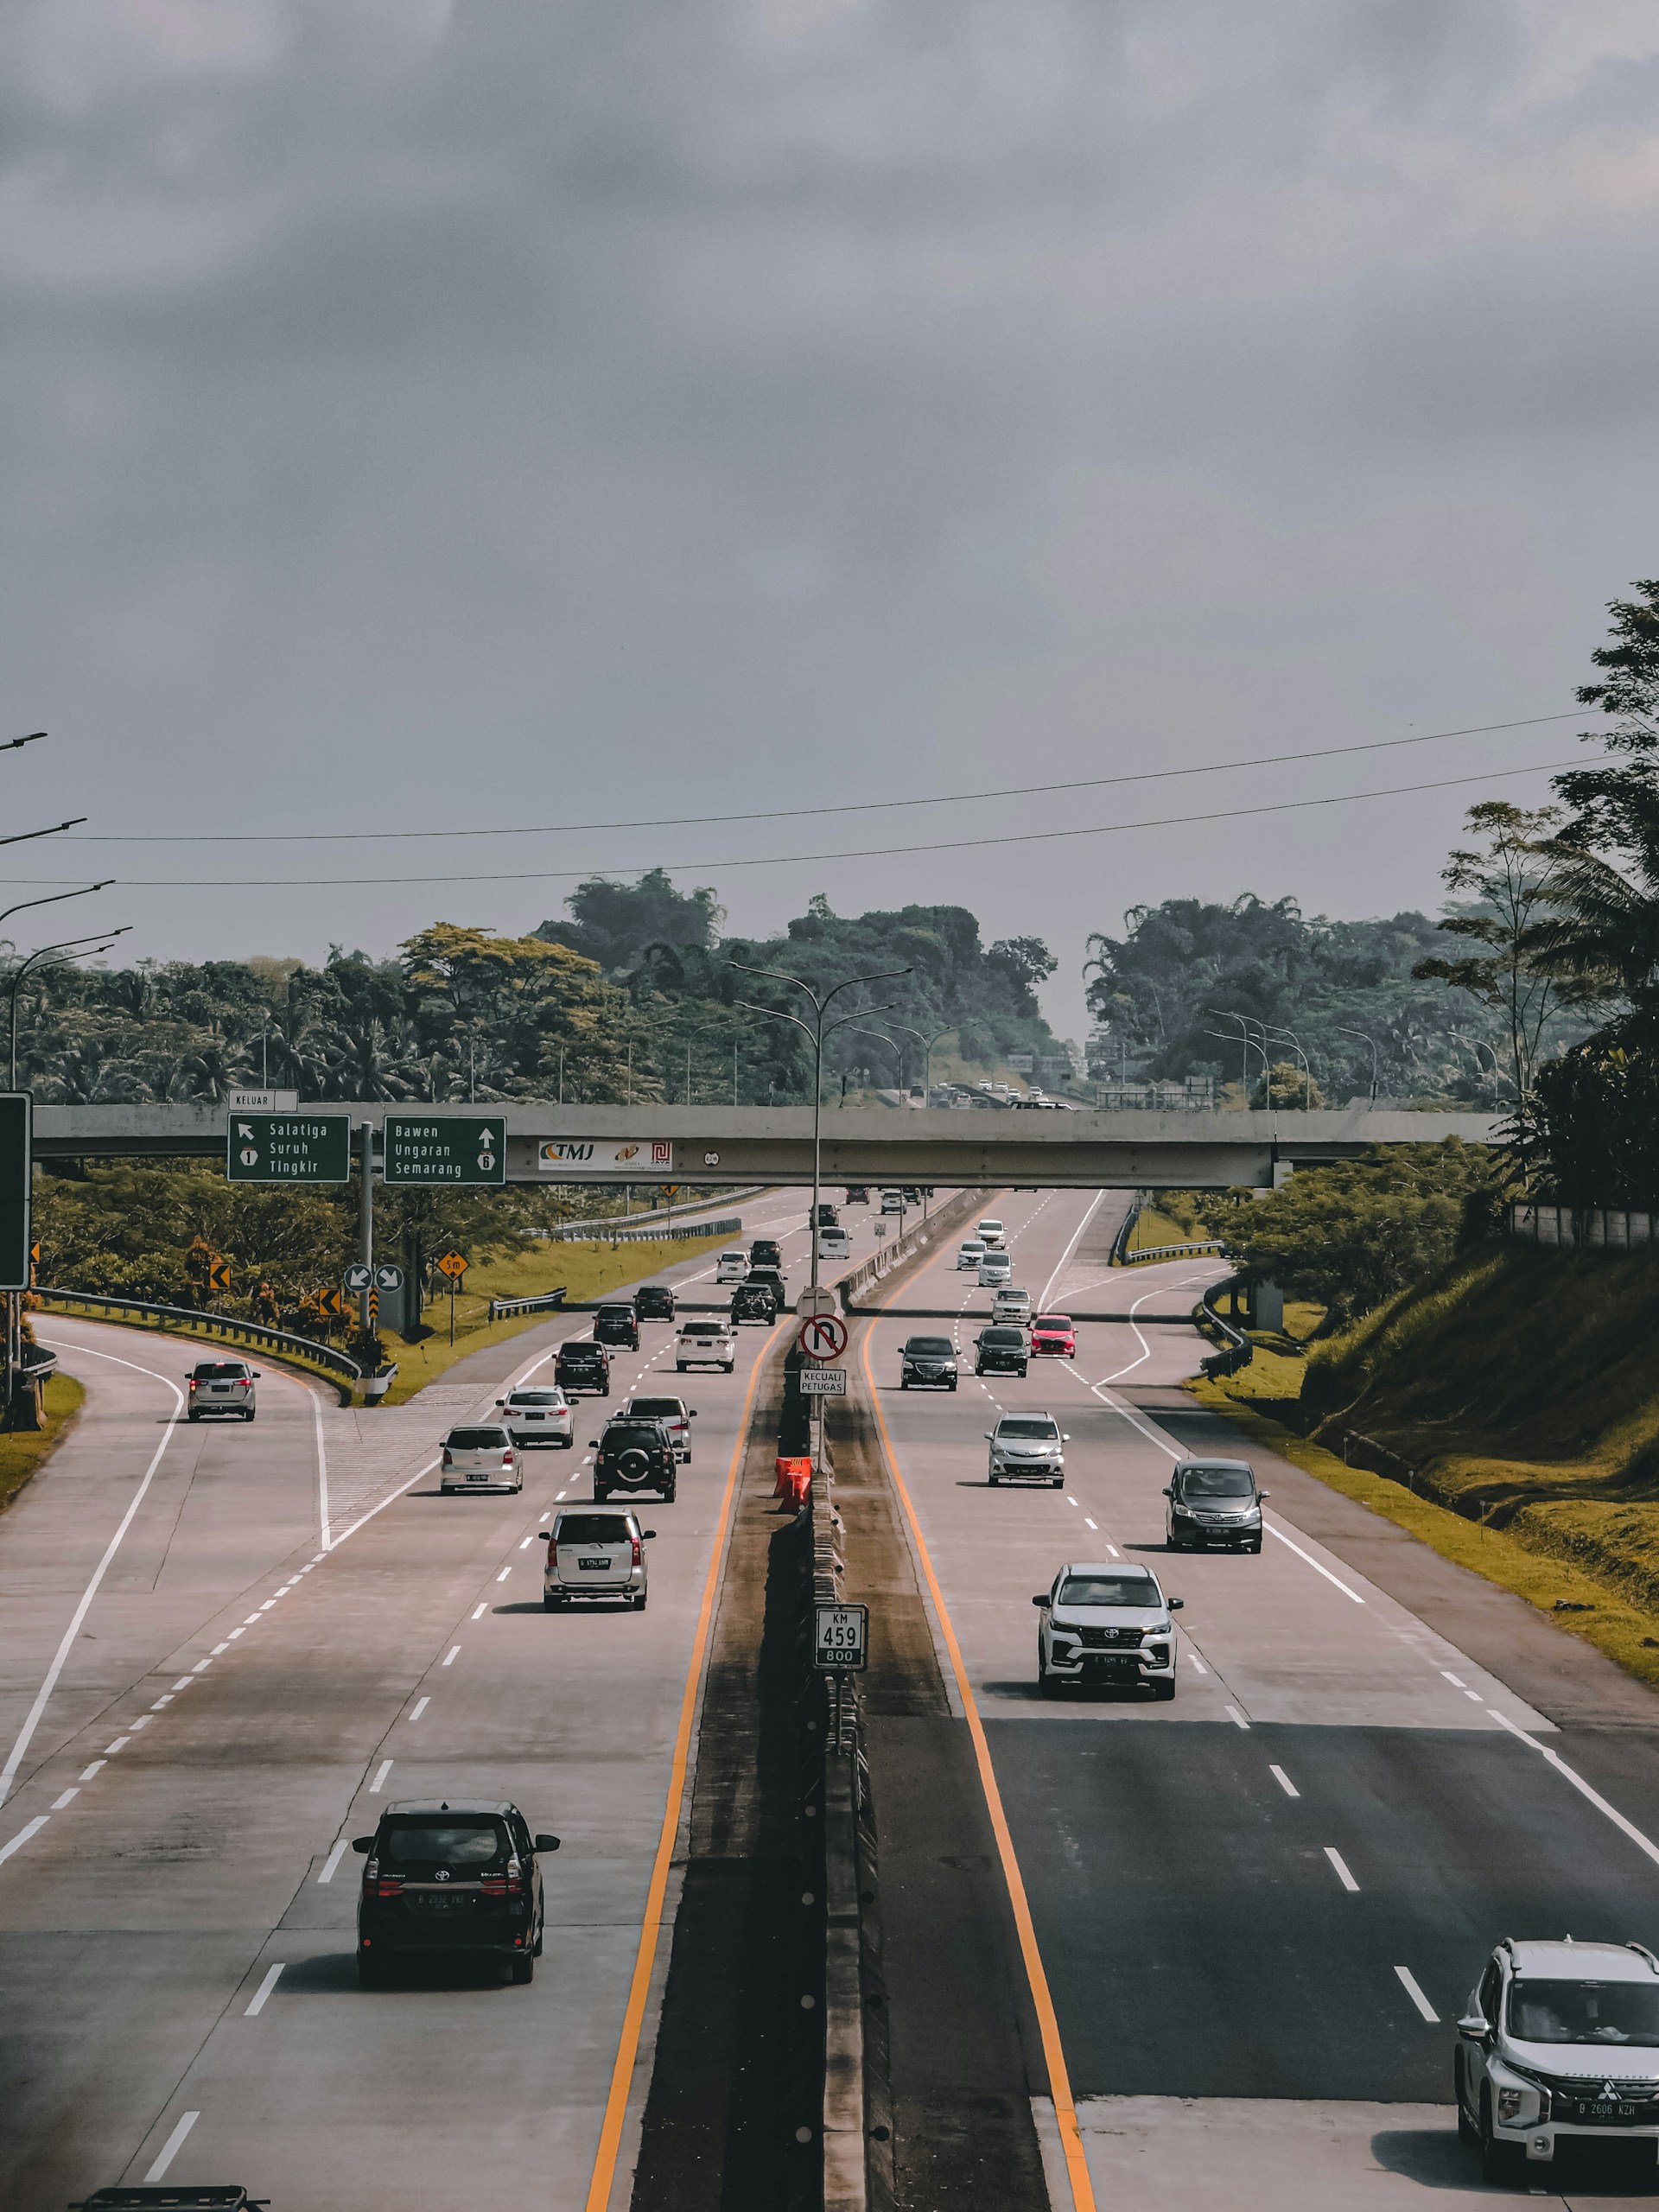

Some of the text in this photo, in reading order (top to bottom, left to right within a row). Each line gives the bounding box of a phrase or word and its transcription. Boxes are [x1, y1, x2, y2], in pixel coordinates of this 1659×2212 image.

[236, 1095, 268, 1105] KELUAR
[270, 1122, 327, 1139] Salatiga
[395, 1125, 438, 1137] Bawen
[270, 1141, 308, 1154] Suruh
[395, 1144, 450, 1159] Ungaran
[556, 1144, 594, 1160] TMJ
[245, 1151, 251, 1164] 1
[482, 1155, 490, 1168] 6
[270, 1160, 318, 1175] Tingkir
[395, 1162, 461, 1178] Semarang
[447, 1260, 451, 1269] 5
[804, 1372, 842, 1382] KECUALI
[802, 1382, 842, 1392] PETUGAS
[833, 1613, 848, 1624] KM
[823, 1626, 856, 1647] 459
[826, 1649, 853, 1662] 800
[1579, 2103, 1635, 2115] B 2606 KZH
